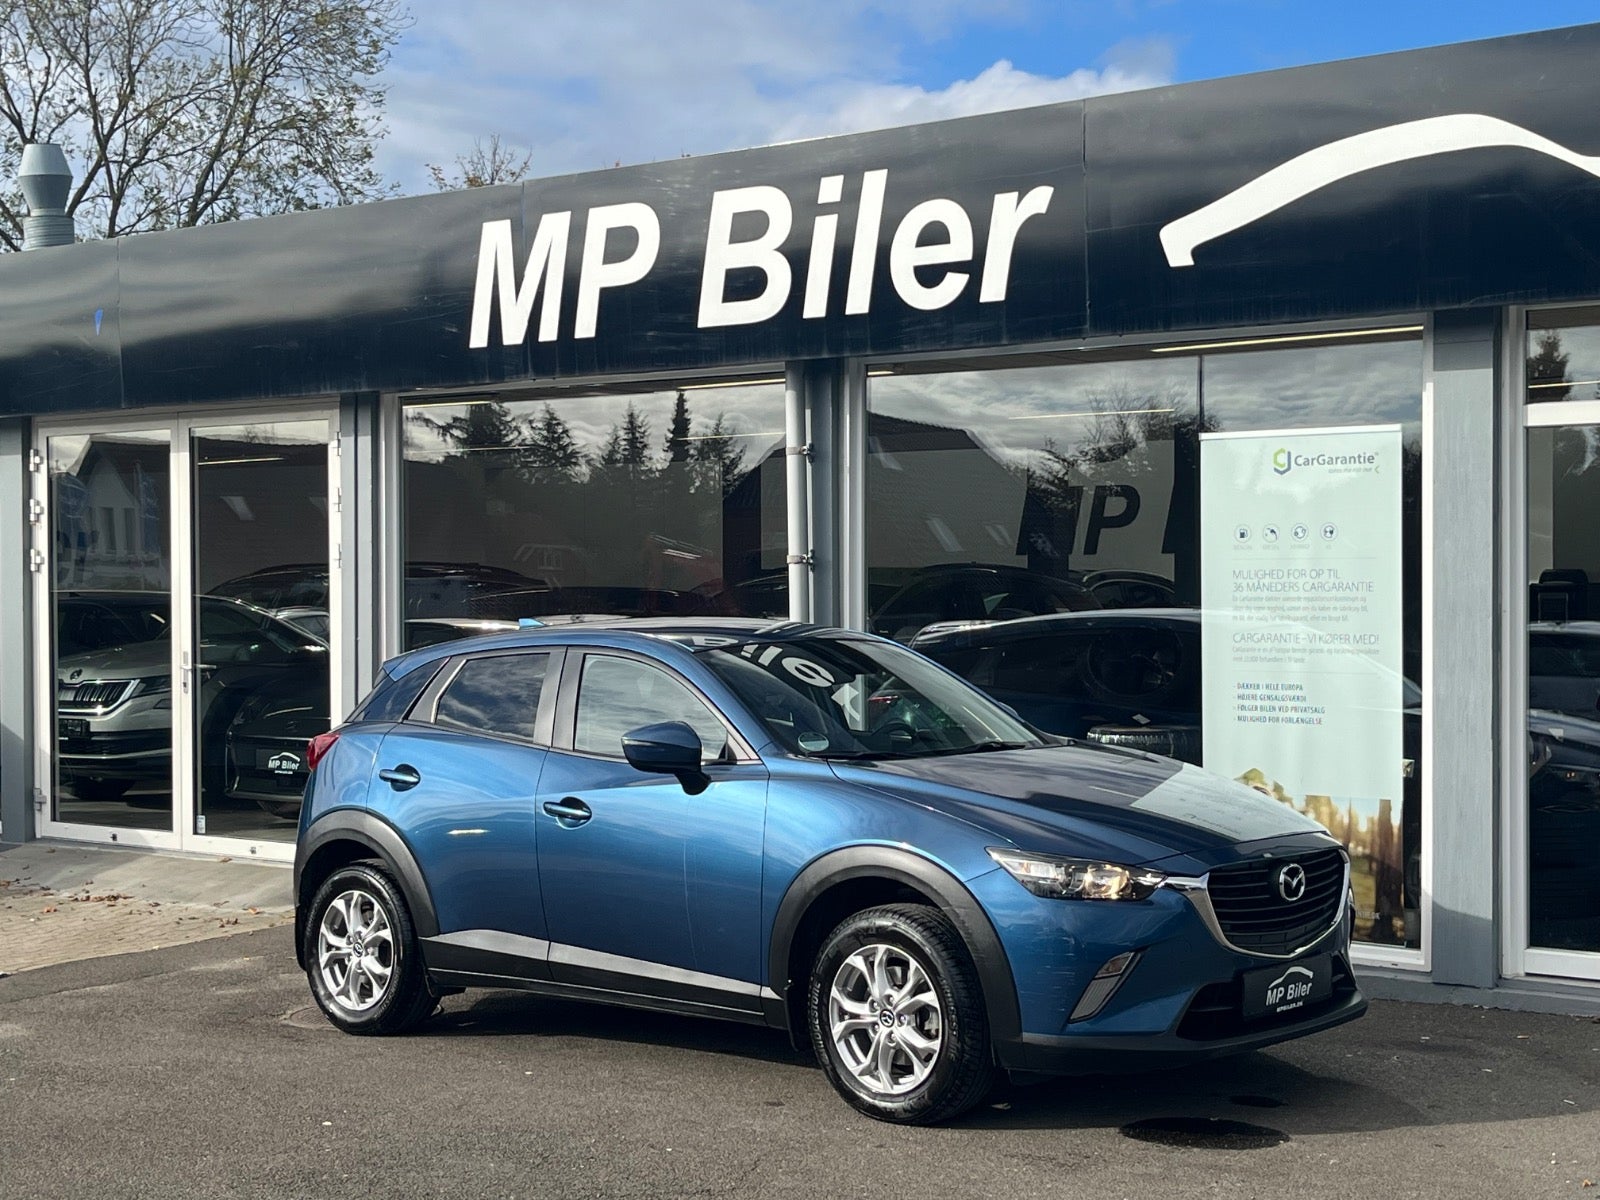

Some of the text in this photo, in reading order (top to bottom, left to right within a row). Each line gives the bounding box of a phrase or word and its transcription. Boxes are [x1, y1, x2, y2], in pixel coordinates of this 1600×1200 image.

[469, 169, 1055, 349] MP Biler
[1232, 568, 1341, 580] MULIGHED FOR OP TIL
[1232, 580, 1375, 593] 36 MÅNEDERS CARGARANTIE
[1237, 715, 1267, 723] MULIGHED
[1265, 982, 1313, 1006] MP Biler
